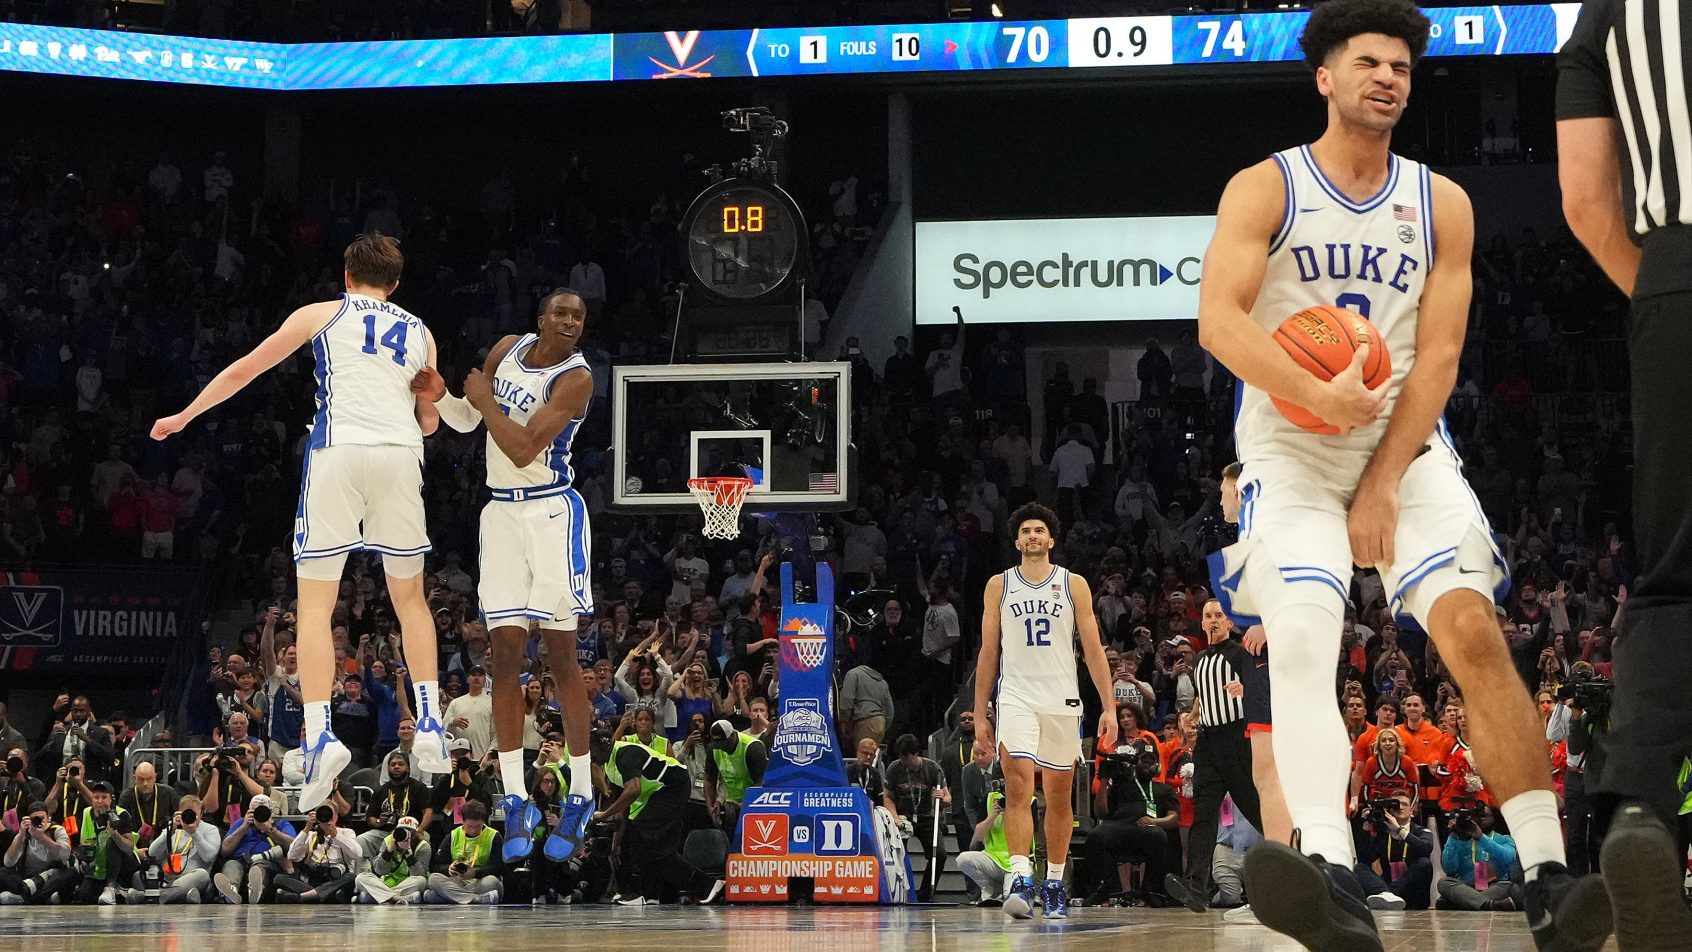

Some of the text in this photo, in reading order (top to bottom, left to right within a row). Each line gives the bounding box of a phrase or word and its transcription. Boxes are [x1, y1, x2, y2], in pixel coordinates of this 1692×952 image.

[1093, 25, 1147, 59] 0.9
[1197, 21, 1246, 58] 74
[1463, 20, 1474, 40] 1
[768, 36, 920, 60] TO 1 FOULS 10
[1002, 26, 1050, 63] 70
[723, 206, 763, 233] 0.8
[953, 252, 1158, 299] Spectrum
[1290, 243, 1419, 294] DUKE
[352, 300, 418, 328] KHAMENIA
[361, 314, 409, 367] 14
[493, 376, 537, 414] DUKE
[73, 609, 177, 637] VIRGINIA
[1010, 600, 1063, 619] DUKE
[1024, 618, 1051, 647] 12
[1115, 687, 1141, 696] DUKE
[774, 733, 831, 747] TOURNAMENT
[749, 792, 794, 807] ACC
[803, 797, 853, 808] GREATNESS
[796, 829, 807, 840] VS
[821, 820, 854, 851] D
[729, 860, 874, 878] CHAMPIONSHIP GAME
